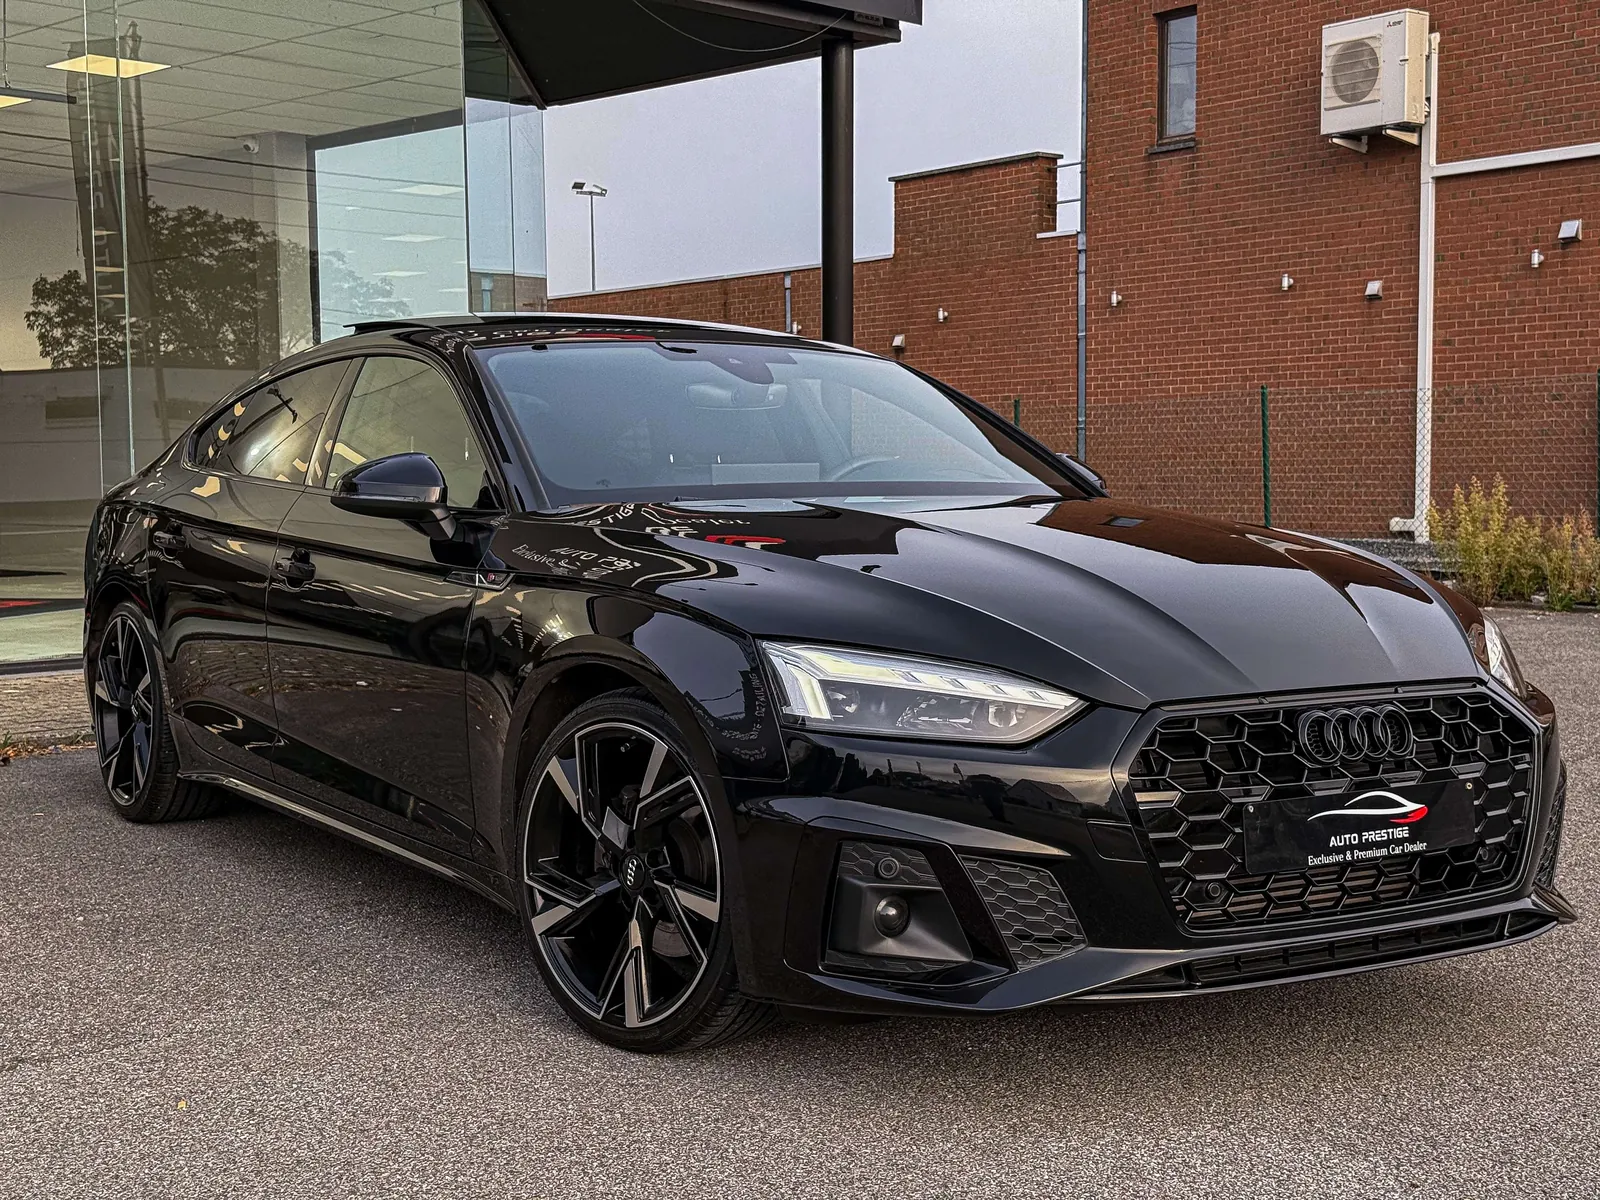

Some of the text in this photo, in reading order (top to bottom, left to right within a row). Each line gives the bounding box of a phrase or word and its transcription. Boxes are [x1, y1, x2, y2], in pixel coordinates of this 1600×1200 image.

[1329, 826, 1410, 848] AUTO PRESTIGE
[1307, 840, 1427, 866] Exclusive & Premium Car Dealer
